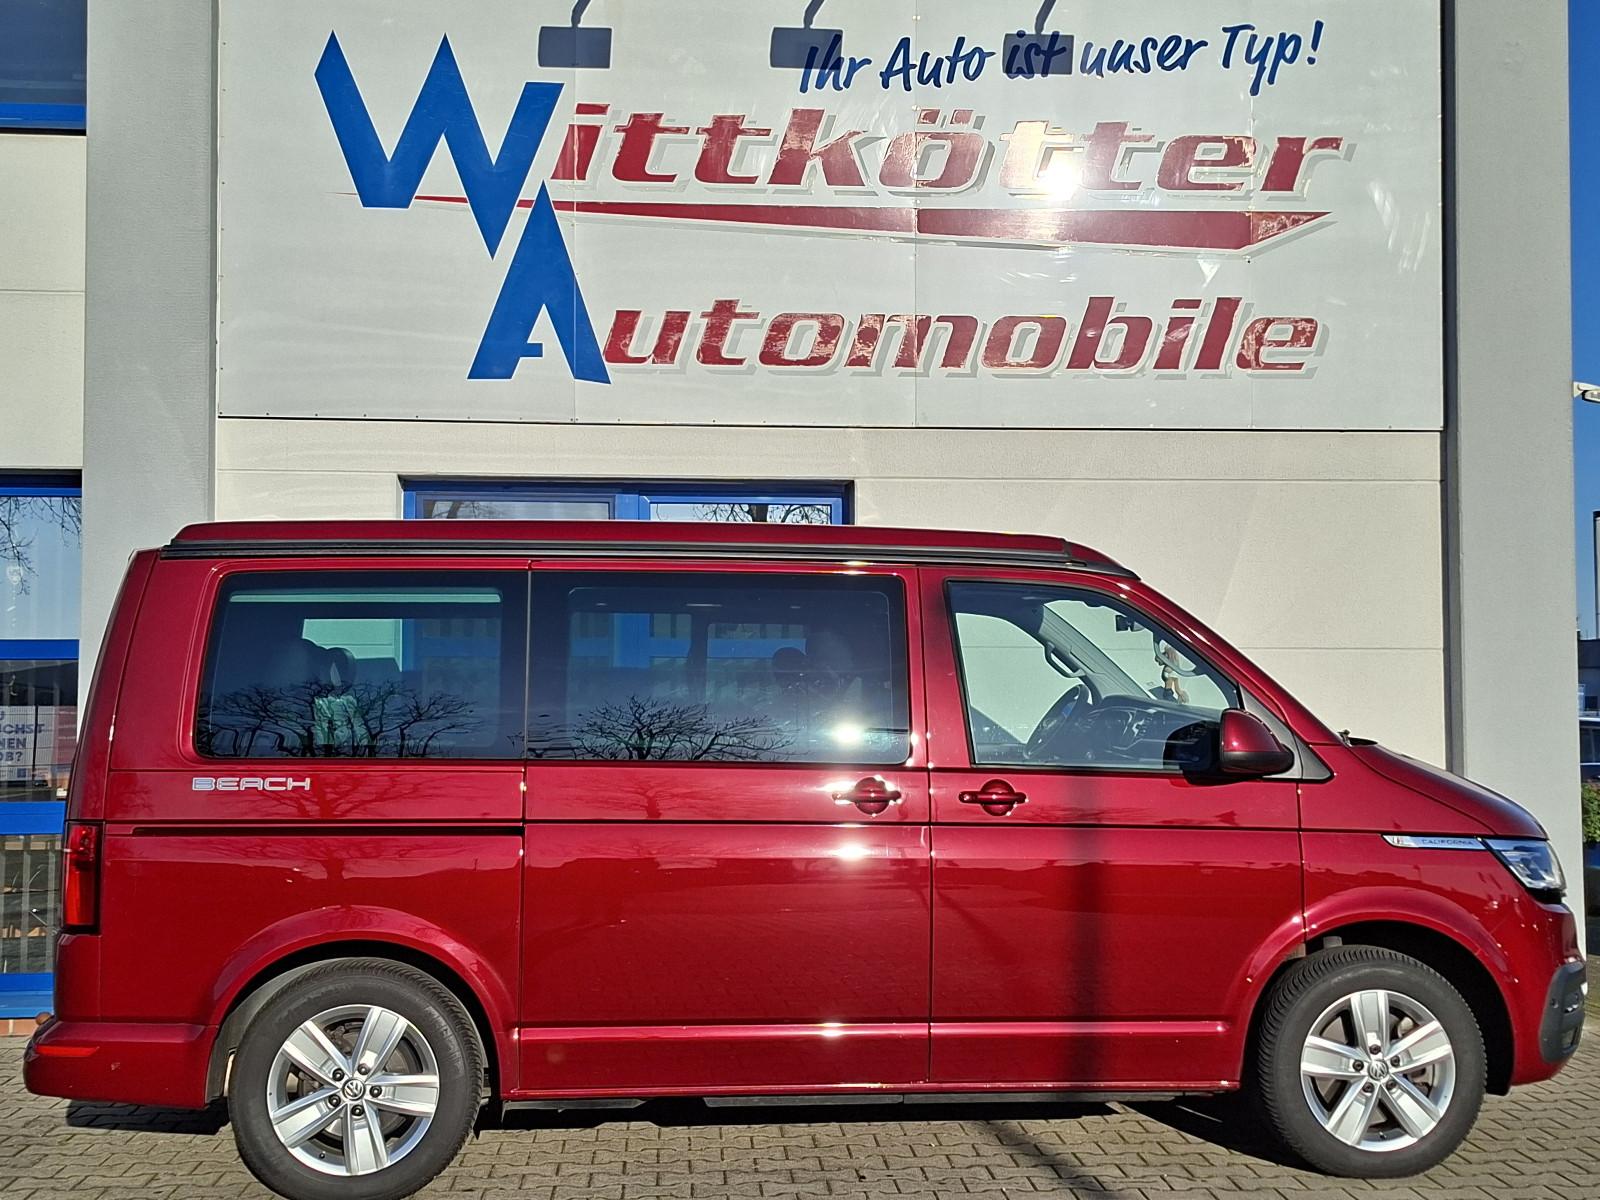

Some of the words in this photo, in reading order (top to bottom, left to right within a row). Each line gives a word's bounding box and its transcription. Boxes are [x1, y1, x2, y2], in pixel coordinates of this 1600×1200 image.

[799, 33, 872, 93] Ihr
[879, 36, 996, 92] Auto
[1005, 30, 1066, 80] ist
[1079, 34, 1208, 79] unser
[1221, 19, 1324, 97] Typ!
[314, 31, 1343, 260] Wittkötter
[467, 180, 1317, 384] Automobile
[192, 777, 311, 791] BEACH
